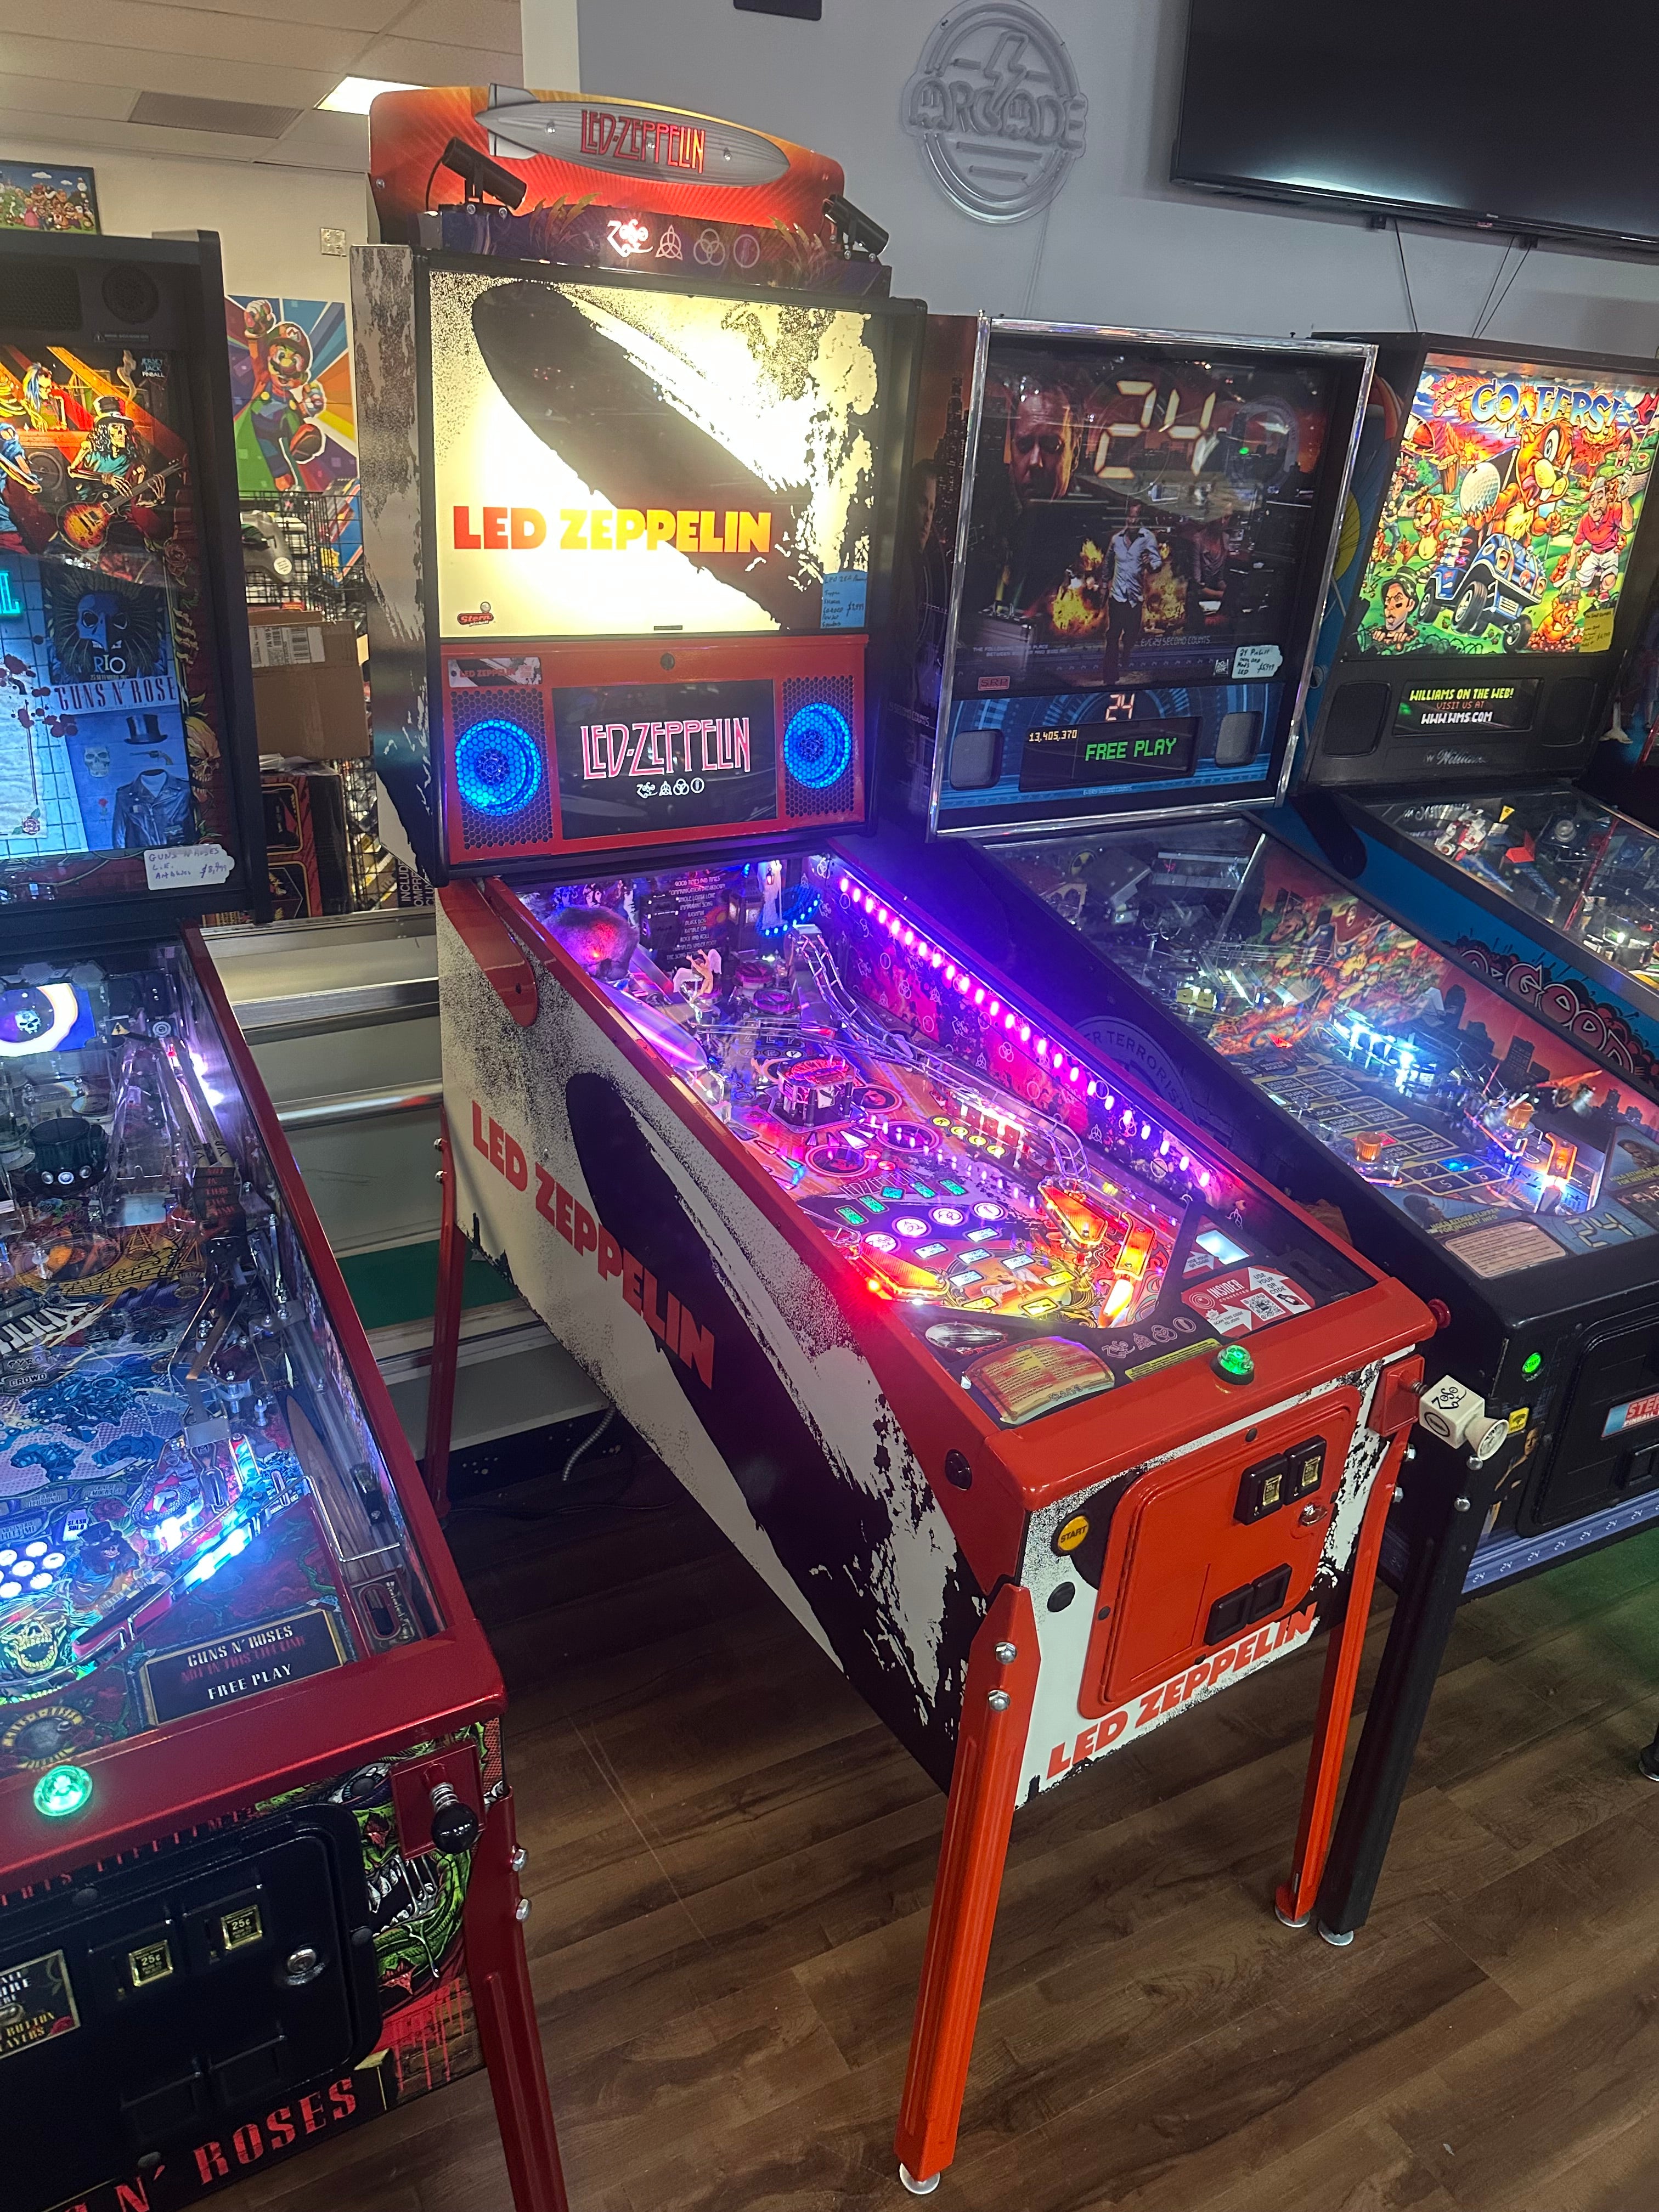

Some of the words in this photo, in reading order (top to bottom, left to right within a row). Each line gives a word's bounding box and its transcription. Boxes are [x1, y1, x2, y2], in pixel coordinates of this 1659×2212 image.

[909, 78, 1087, 149] ARCADE
[1094, 380, 1216, 479] 24
[454, 506, 546, 549] LED
[560, 509, 771, 553] ZEPPELIN
[460, 614, 492, 623] Stern
[1141, 637, 1162, 647] EVERY
[1163, 636, 1187, 646] SECOND
[1187, 636, 1211, 645] COUNTS
[93, 654, 126, 674] RIO
[459, 669, 476, 678] LED
[476, 668, 516, 678] ZEPPELIN
[981, 677, 1008, 689] SRP
[55, 683, 106, 711] GUNS
[1409, 689, 1455, 701] WILLIAMS
[1457, 689, 1471, 700] ON
[1473, 689, 1489, 699] THE
[1491, 688, 1514, 699] WEB!
[1105, 693, 1135, 721] 24
[1436, 702, 1459, 710] VISIT
[1421, 711, 1493, 725] WWW.WMS.COM
[1029, 730, 1078, 743] 13,405,370
[1085, 742, 1128, 761] FREE
[1133, 737, 1177, 758] PLAY
[1562, 1212, 1634, 1249] 24
[472, 1100, 528, 1192] LED
[535, 1161, 715, 1390] ZEPPELIN
[1206, 1279, 1245, 1299] INSIDER
[1257, 1277, 1274, 1285] YOUR
[1269, 1285, 1287, 1295] CODE
[1219, 1289, 1250, 1303] CONNECTED
[8, 1354, 42, 1369] PYRO
[10, 1373, 47, 1387] CROWD
[67, 1518, 87, 1526] SLASH
[1060, 1525, 1087, 1544] START
[187, 1645, 228, 1667] GUNS
[248, 1625, 294, 1649] ROSES
[208, 1678, 247, 1700] FREE
[251, 1663, 292, 1686] PLAY
[1047, 1711, 1128, 1780] LED
[1135, 1601, 1318, 1729] ZEPPELIN
[193, 2077, 358, 2186] ROSES
